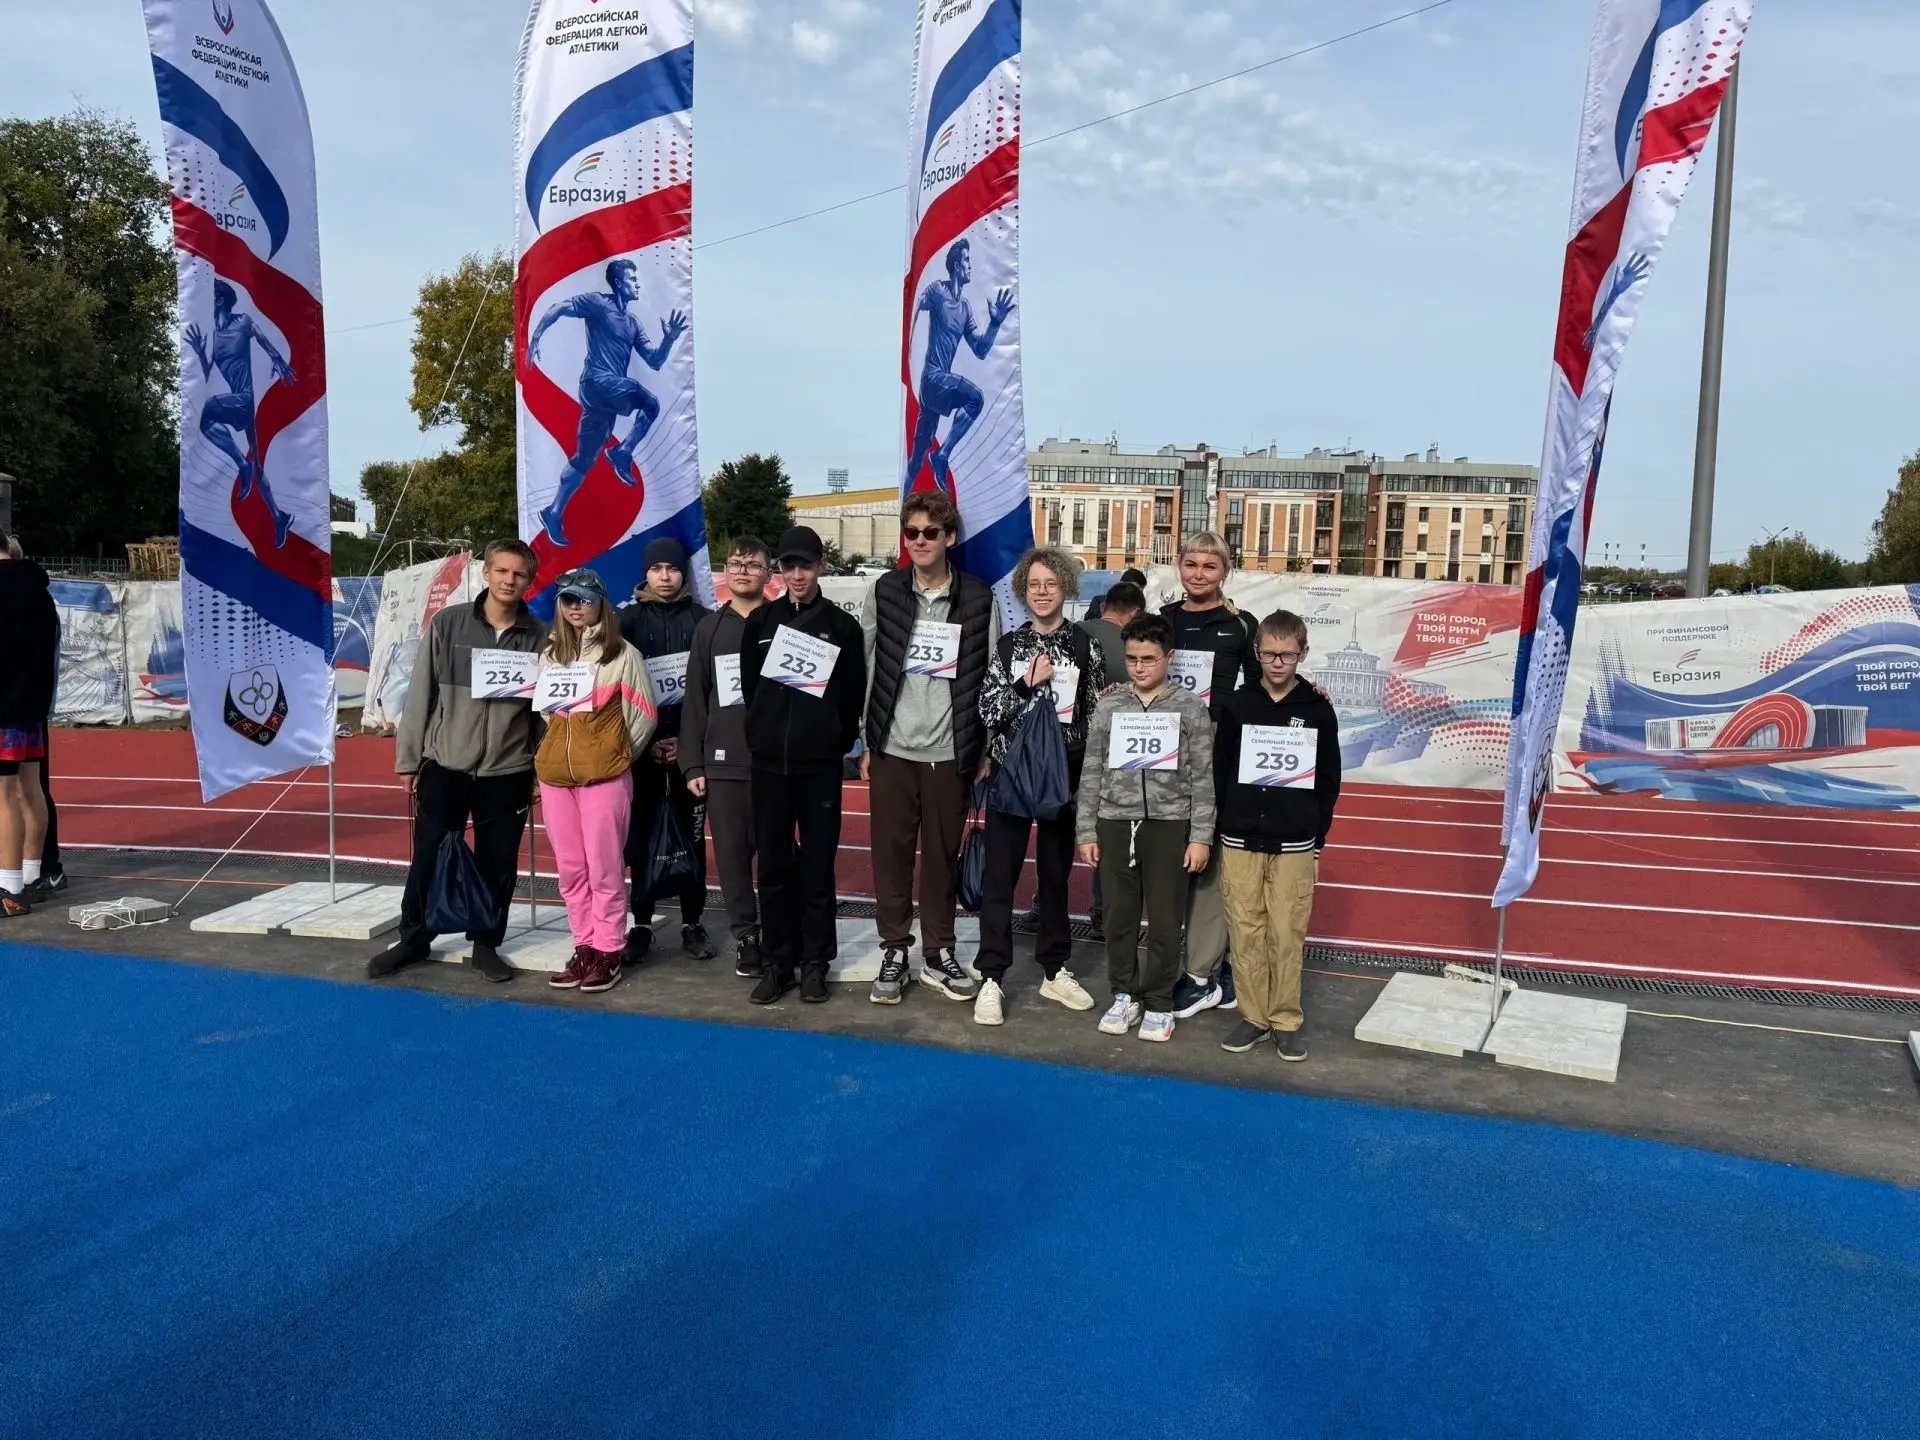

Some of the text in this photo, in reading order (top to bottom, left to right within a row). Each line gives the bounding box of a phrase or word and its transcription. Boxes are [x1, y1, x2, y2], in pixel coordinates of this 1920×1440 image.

[555, 10, 639, 31] ВСЕРОССИЙСКАЯ
[545, 23, 648, 46] ФЕДЕРАЦИЯ ЛЕГКОЙ
[195, 35, 262, 66] ВСЕРОССИЙСКАЯ
[569, 41, 619, 55] АТЛЕТИКИ
[191, 49, 270, 83] ФЕДЕРАЦИЯ ЛЕГКОЙ
[215, 70, 249, 89] АТЛЕТИКИ
[549, 186, 626, 206] Евразия
[213, 212, 256, 231] вразия
[1416, 612, 1487, 626] ТВОЙ ГОРОД
[1416, 623, 1480, 635] ТВОЙ РИТМ
[1646, 624, 1729, 636] ПРИ ФИНАНСОВОЙ
[1415, 633, 1469, 645] ТВОЙ БЕГ
[1662, 633, 1717, 642] ПОДДЕРЖКЕ
[908, 644, 944, 662] 233
[779, 653, 818, 680] 232
[1855, 661, 1920, 671] ТВОЙ ГОРО
[485, 671, 526, 685] 234
[1652, 670, 1721, 685] Евразия
[1855, 671, 1920, 681] ТВОЙ РИТМ
[548, 683, 578, 698] 231
[656, 675, 687, 693] 196
[1856, 681, 1911, 692] ТВОЙ БЕГ
[1126, 738, 1162, 754] 218
[1255, 752, 1300, 771] 239
